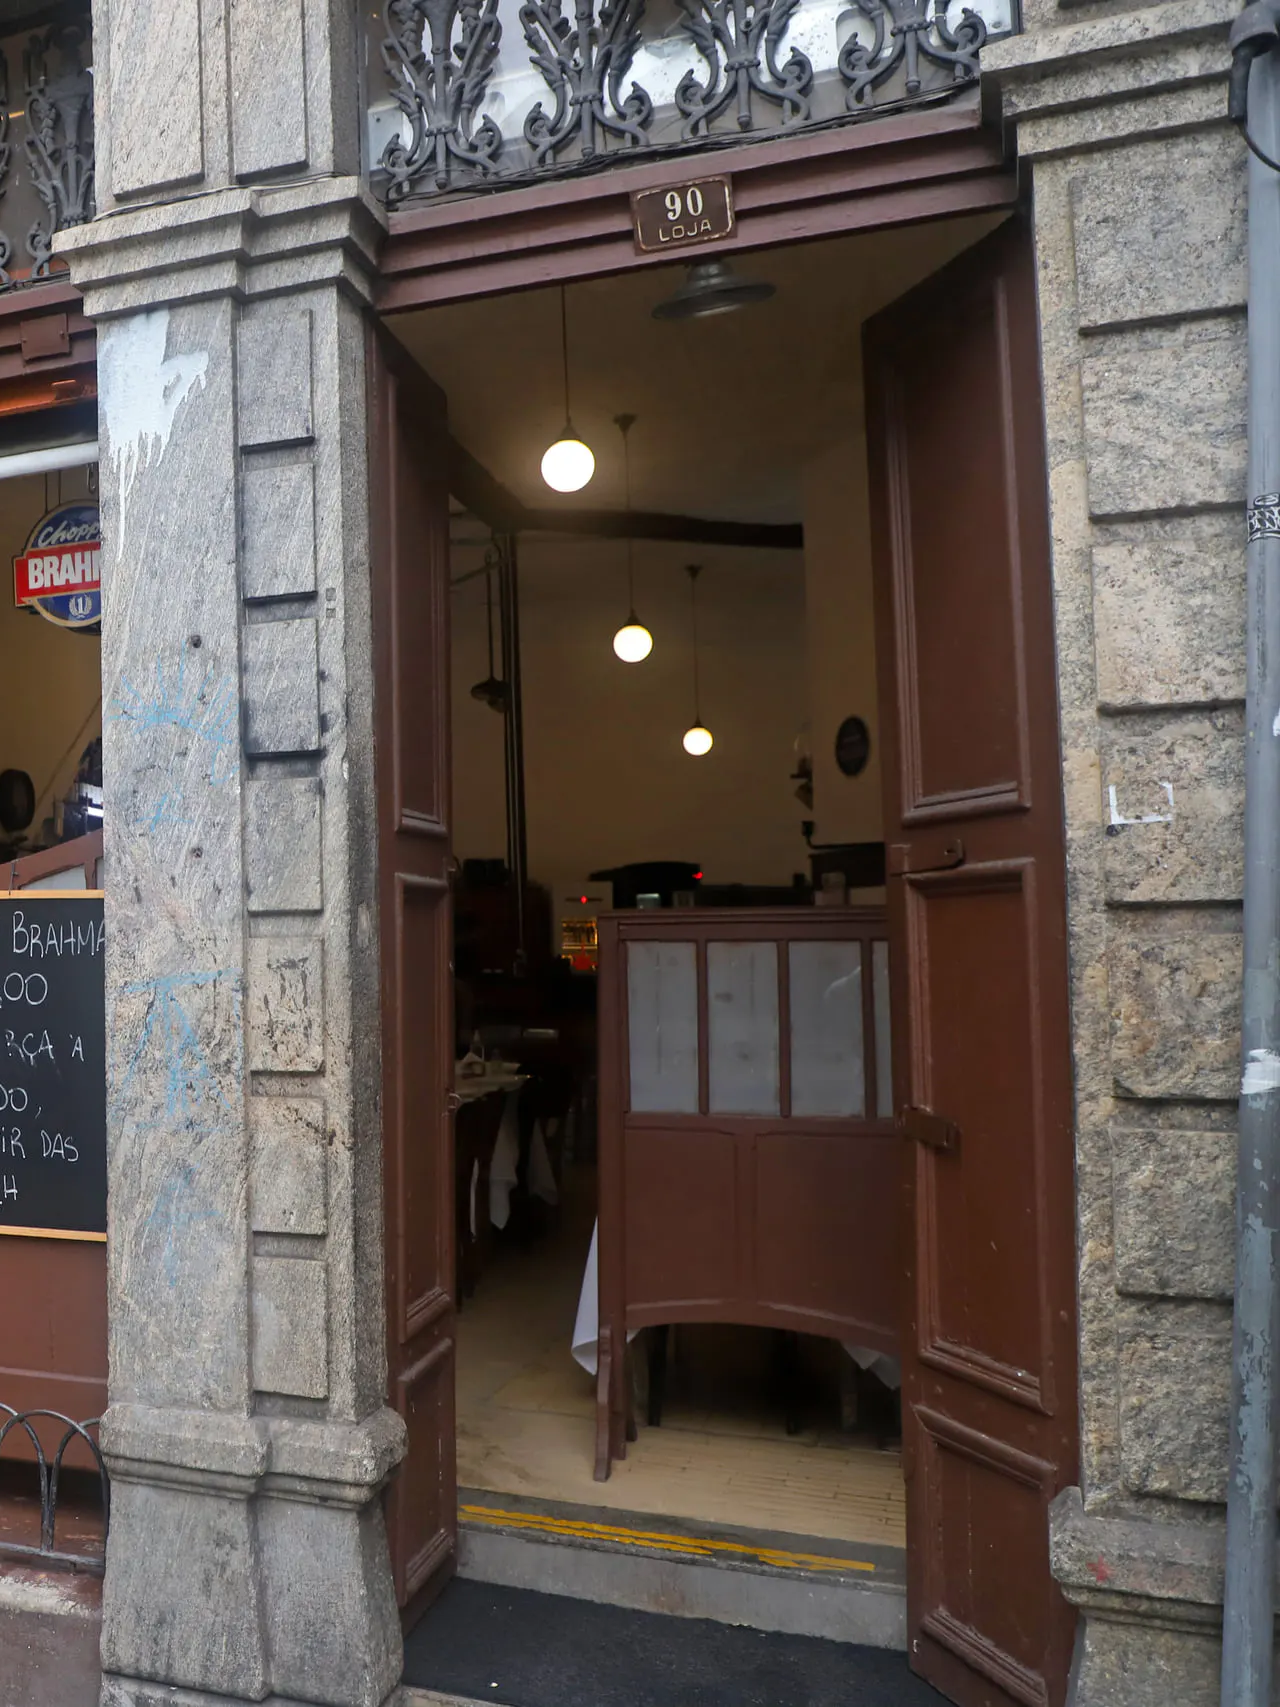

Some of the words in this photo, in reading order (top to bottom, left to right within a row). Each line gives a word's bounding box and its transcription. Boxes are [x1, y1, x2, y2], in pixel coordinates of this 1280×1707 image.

[665, 187, 703, 220] 90
[659, 219, 712, 241] LOJA
[40, 1129, 79, 1162] DAS
[3, 1174, 18, 1200] H
